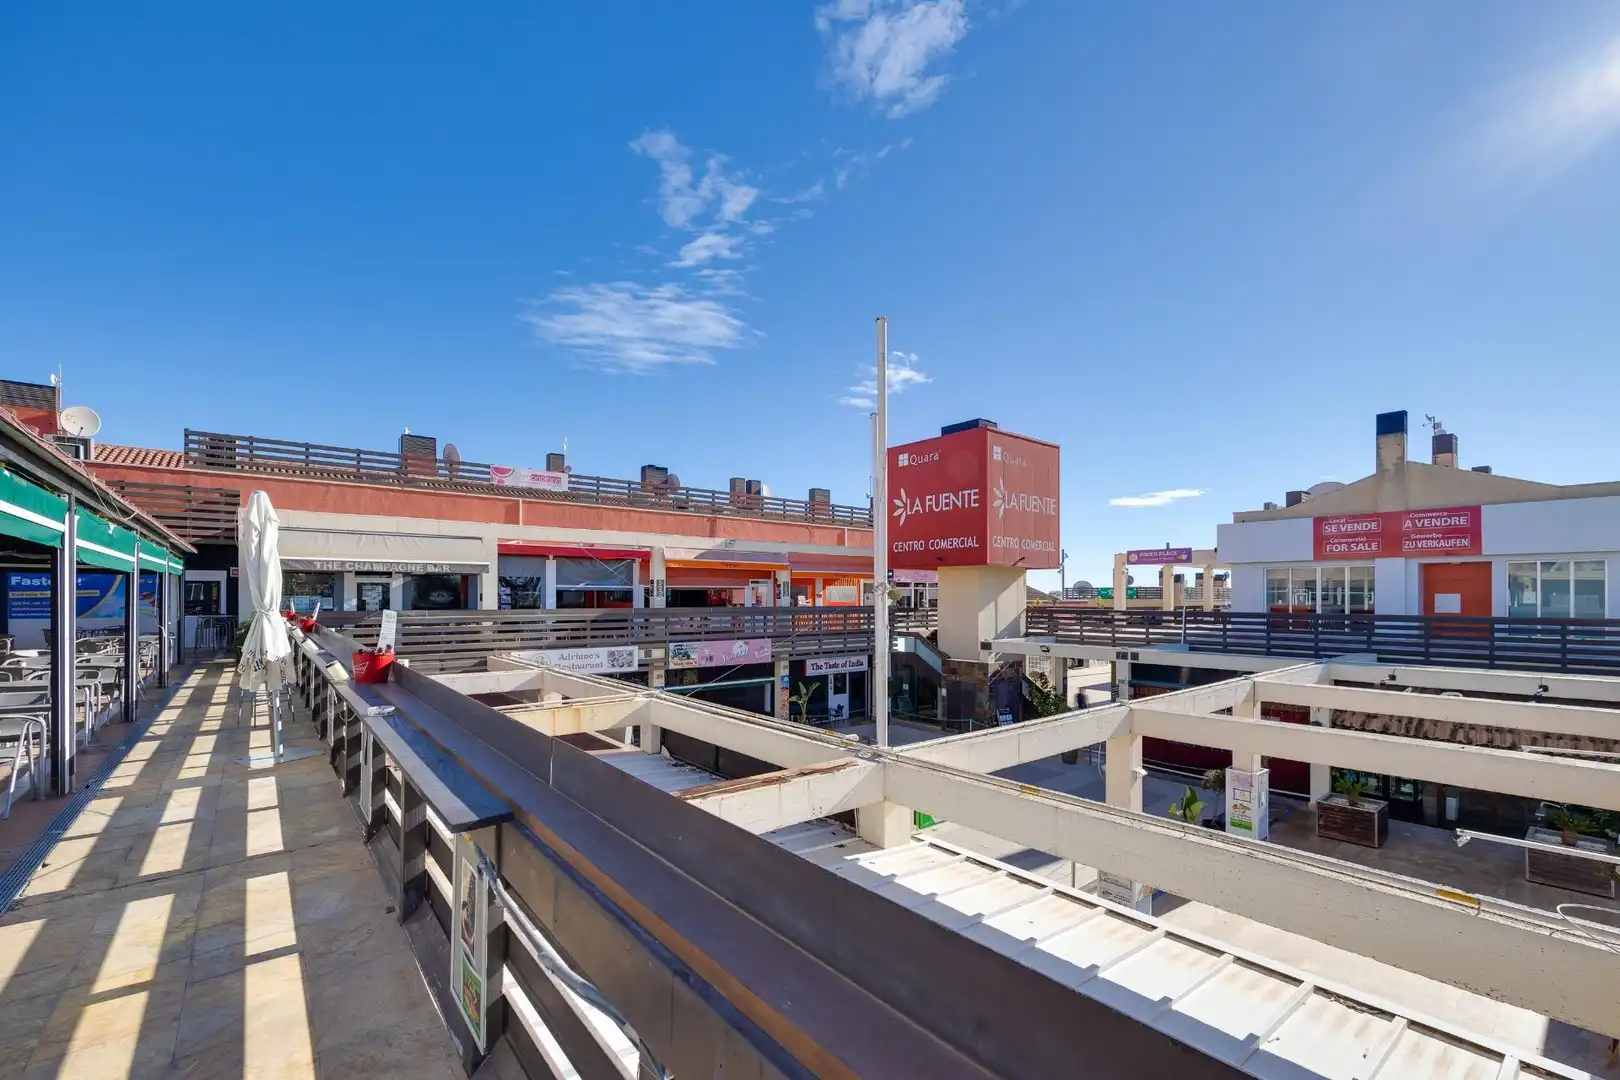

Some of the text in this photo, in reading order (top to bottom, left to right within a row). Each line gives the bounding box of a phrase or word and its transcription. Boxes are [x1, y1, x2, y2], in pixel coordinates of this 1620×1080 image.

[909, 451, 939, 466] Quara
[1003, 451, 1027, 467] Quara
[907, 488, 980, 516] LA FUENTE
[1004, 490, 1057, 516] LA FUENTE
[1324, 521, 1378, 533] SE VENDE
[1404, 516, 1468, 528] A VENDRE
[893, 536, 980, 553] CENTRO COMERCIAL
[992, 535, 1056, 552] CENTRO COMERCIAL
[1326, 542, 1378, 552] FOR SALE
[1404, 538, 1469, 549] ZU VERKAUFEN
[314, 561, 452, 573] THE CHAMPAGNE BAR
[810, 662, 823, 671] The
[823, 661, 840, 670] Taste
[840, 660, 848, 668] of
[848, 659, 864, 668] India
